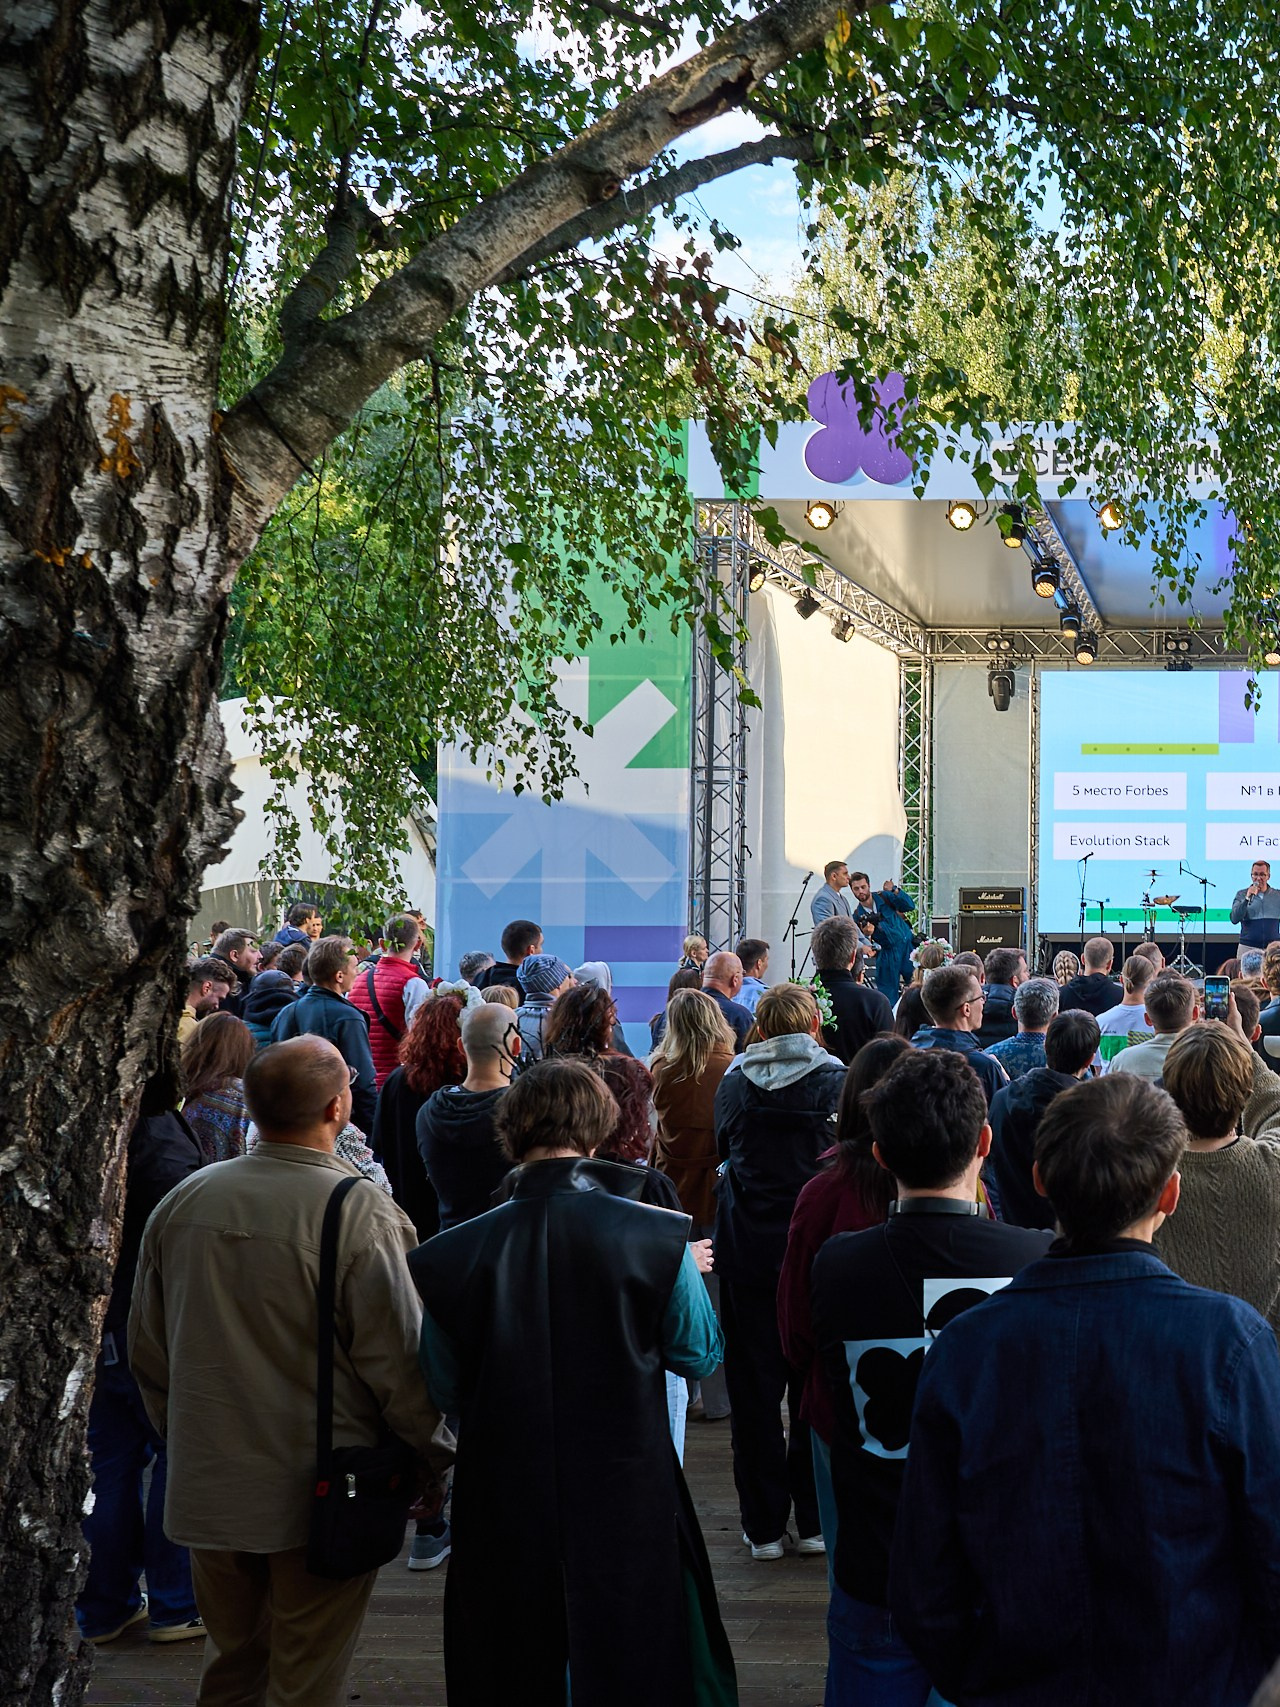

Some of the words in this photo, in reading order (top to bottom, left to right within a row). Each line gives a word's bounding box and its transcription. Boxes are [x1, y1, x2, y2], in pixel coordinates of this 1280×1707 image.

[1072, 784, 1080, 796] 5
[1083, 787, 1122, 796] место
[1125, 784, 1169, 796] Forbes
[1241, 785, 1262, 796] №1
[1267, 787, 1274, 796] в
[1070, 834, 1131, 846] Evolution
[1134, 834, 1170, 846] Stack
[1239, 835, 1252, 846] AI
[977, 892, 1005, 900] Marshall
[976, 935, 1003, 944] Marshall
